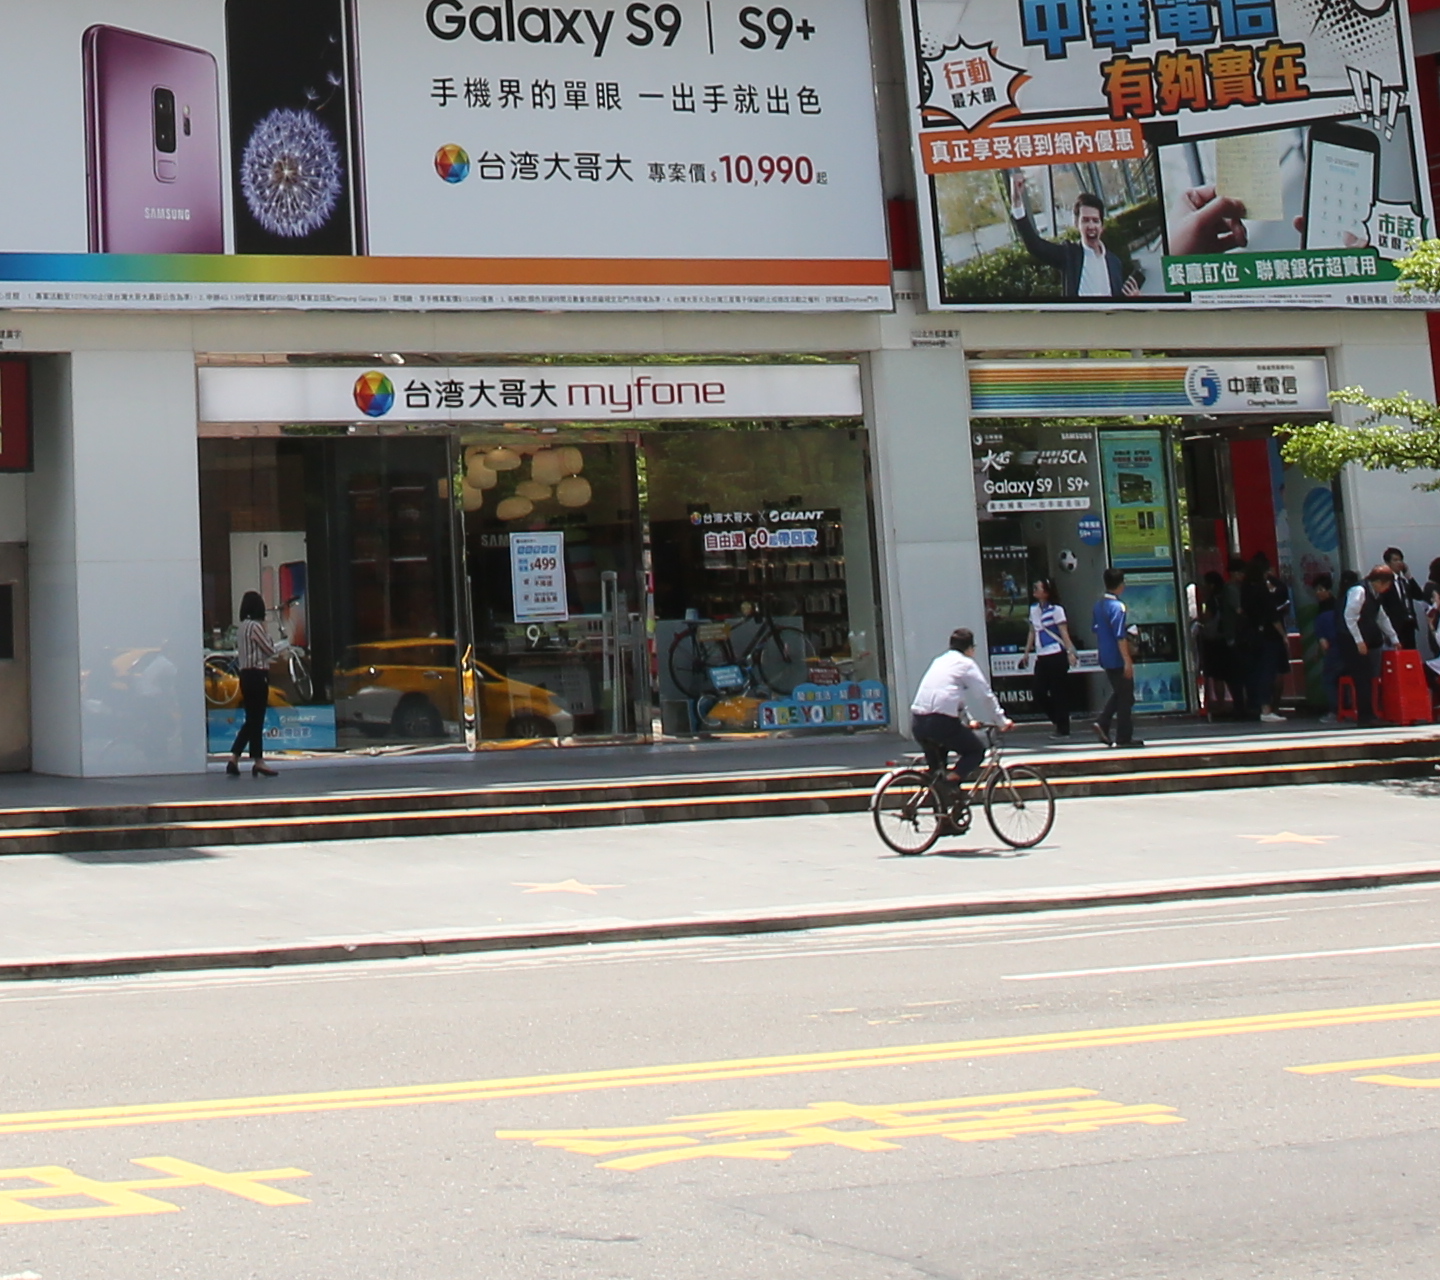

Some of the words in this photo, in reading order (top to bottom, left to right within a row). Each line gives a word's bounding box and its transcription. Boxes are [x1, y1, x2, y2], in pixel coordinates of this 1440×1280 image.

[624, 2, 682, 48] S9
[738, 5, 817, 51] S9+
[942, 56, 993, 90] 行動
[1101, 39, 1310, 121] 有夠實在
[428, 76, 623, 112] 手機界的單眼
[637, 84, 823, 116] 一出手就出色
[951, 87, 997, 109] 最大網
[930, 128, 1135, 164] 真正享受得到網內優惠
[144, 207, 191, 221] SAMSUNG
[1378, 213, 1415, 238] 市話
[566, 374, 726, 413] myfone
[1228, 375, 1298, 396] 中華電信
[983, 479, 1034, 497] Galaxy
[1036, 478, 1053, 493] S9
[1066, 476, 1090, 492] S9+
[780, 509, 824, 522] GIANT
[530, 556, 557, 572] $499
[995, 689, 1034, 704] SAMSU
[763, 704, 799, 726] RIDE
[801, 704, 846, 724] YOUR
[847, 699, 885, 722] BIKE
